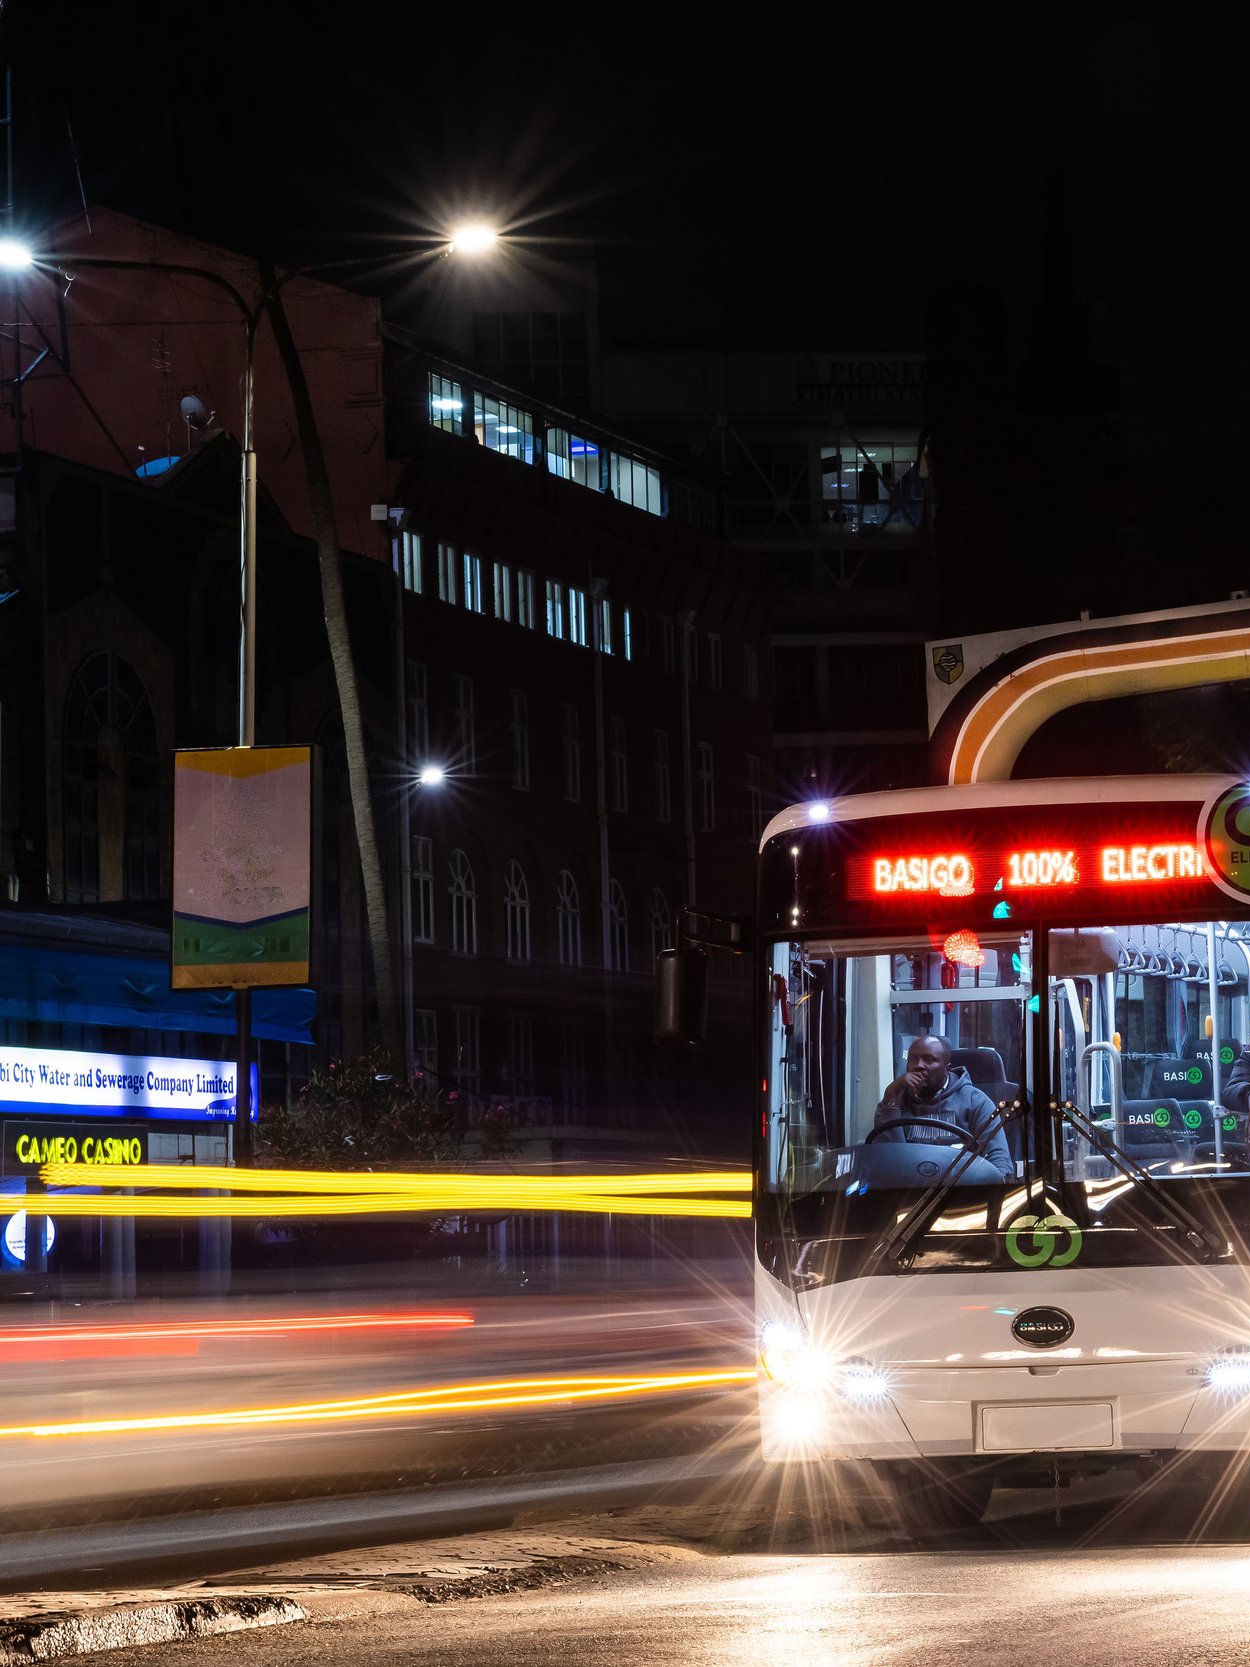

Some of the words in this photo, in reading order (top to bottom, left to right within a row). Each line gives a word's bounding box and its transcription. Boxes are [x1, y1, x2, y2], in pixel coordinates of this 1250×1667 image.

[874, 856, 972, 893] BASIGO
[1008, 850, 1076, 886] 100%
[13, 1062, 36, 1088] City
[38, 1064, 71, 1086] Water
[73, 1068, 93, 1088] and
[95, 1067, 145, 1095] Sewerage
[146, 1071, 194, 1097] Company
[196, 1074, 234, 1094] Limited
[16, 1134, 78, 1164] CAMEO
[81, 1137, 142, 1165] CASINO
